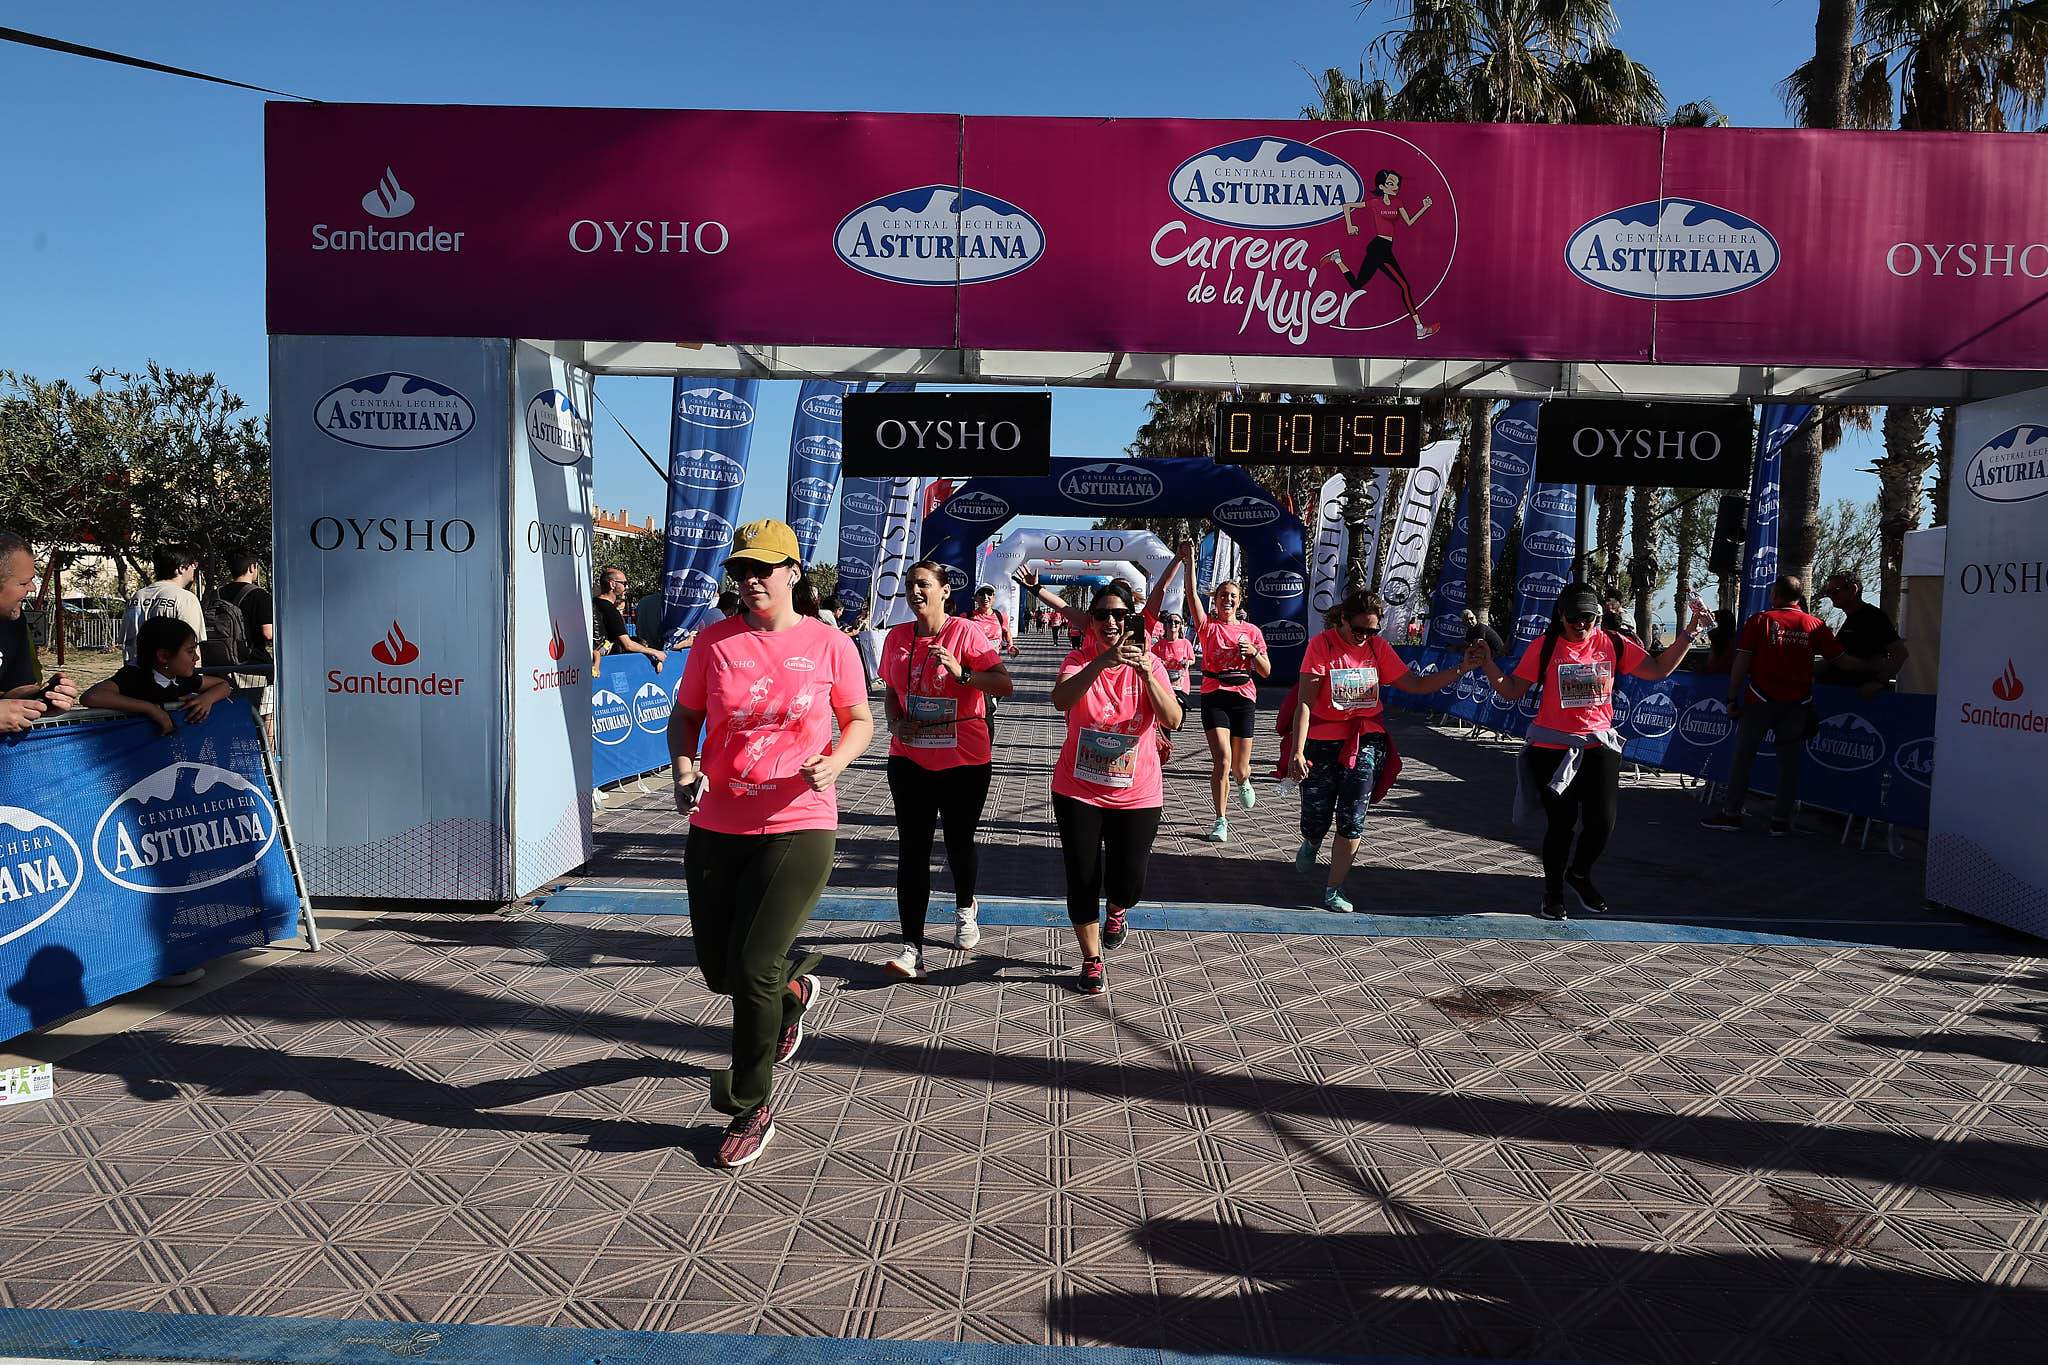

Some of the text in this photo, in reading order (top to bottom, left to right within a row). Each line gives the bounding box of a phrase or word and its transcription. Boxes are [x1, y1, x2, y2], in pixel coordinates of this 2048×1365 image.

[1214, 167, 1343, 179] CENTRAL LECHERA
[1183, 169, 1347, 207] ASTURIANA
[312, 224, 464, 252] Santander
[568, 219, 730, 254] OYSHO
[882, 219, 948, 230] CENTRAL
[1615, 232, 1758, 244] CENTRAL LECHERA
[849, 221, 1029, 259] ASTURIANA
[1150, 220, 1310, 271] Carrera
[1580, 234, 1763, 274] ASTURIANA
[1187, 267, 1368, 345] de la Mujer
[326, 400, 464, 432] ASTURIANA
[351, 399, 459, 409] CENTRAL LECHERA
[678, 398, 748, 422] ASTURIANA
[531, 409, 582, 452] ASTURIANA
[875, 419, 1021, 450] OYSHO
[1230, 413, 1405, 456] 01:01:50
[1572, 427, 1722, 461] OYSHO
[1989, 451, 2025, 463] CENTRAL
[672, 460, 739, 484] ASTURIANA
[1066, 475, 1155, 496] ASTURIANA
[1972, 459, 2048, 488] ASTURIA
[845, 497, 883, 512] ASTURIANA
[949, 502, 1004, 515] ASTURIANA
[1219, 508, 1276, 519] ASTURIANA
[310, 516, 475, 553] OYSHO
[528, 520, 585, 557] OYSHO
[1044, 535, 1124, 553] OYSHO
[1384, 466, 1441, 606] OYSHO
[1313, 498, 1344, 614] OYSHO
[1960, 561, 2048, 595] OYSH
[533, 665, 580, 691] Santander
[720, 659, 755, 670] OSHO
[327, 670, 464, 696] Santander
[592, 713, 631, 734] ASTURIANA
[1633, 708, 1673, 728] ASTURIANA
[1682, 713, 1727, 736] ASTURIANA
[1811, 734, 1875, 761] ASTURIANA
[138, 807, 199, 826] CENTRAL
[114, 812, 267, 874] ASTURIANA
